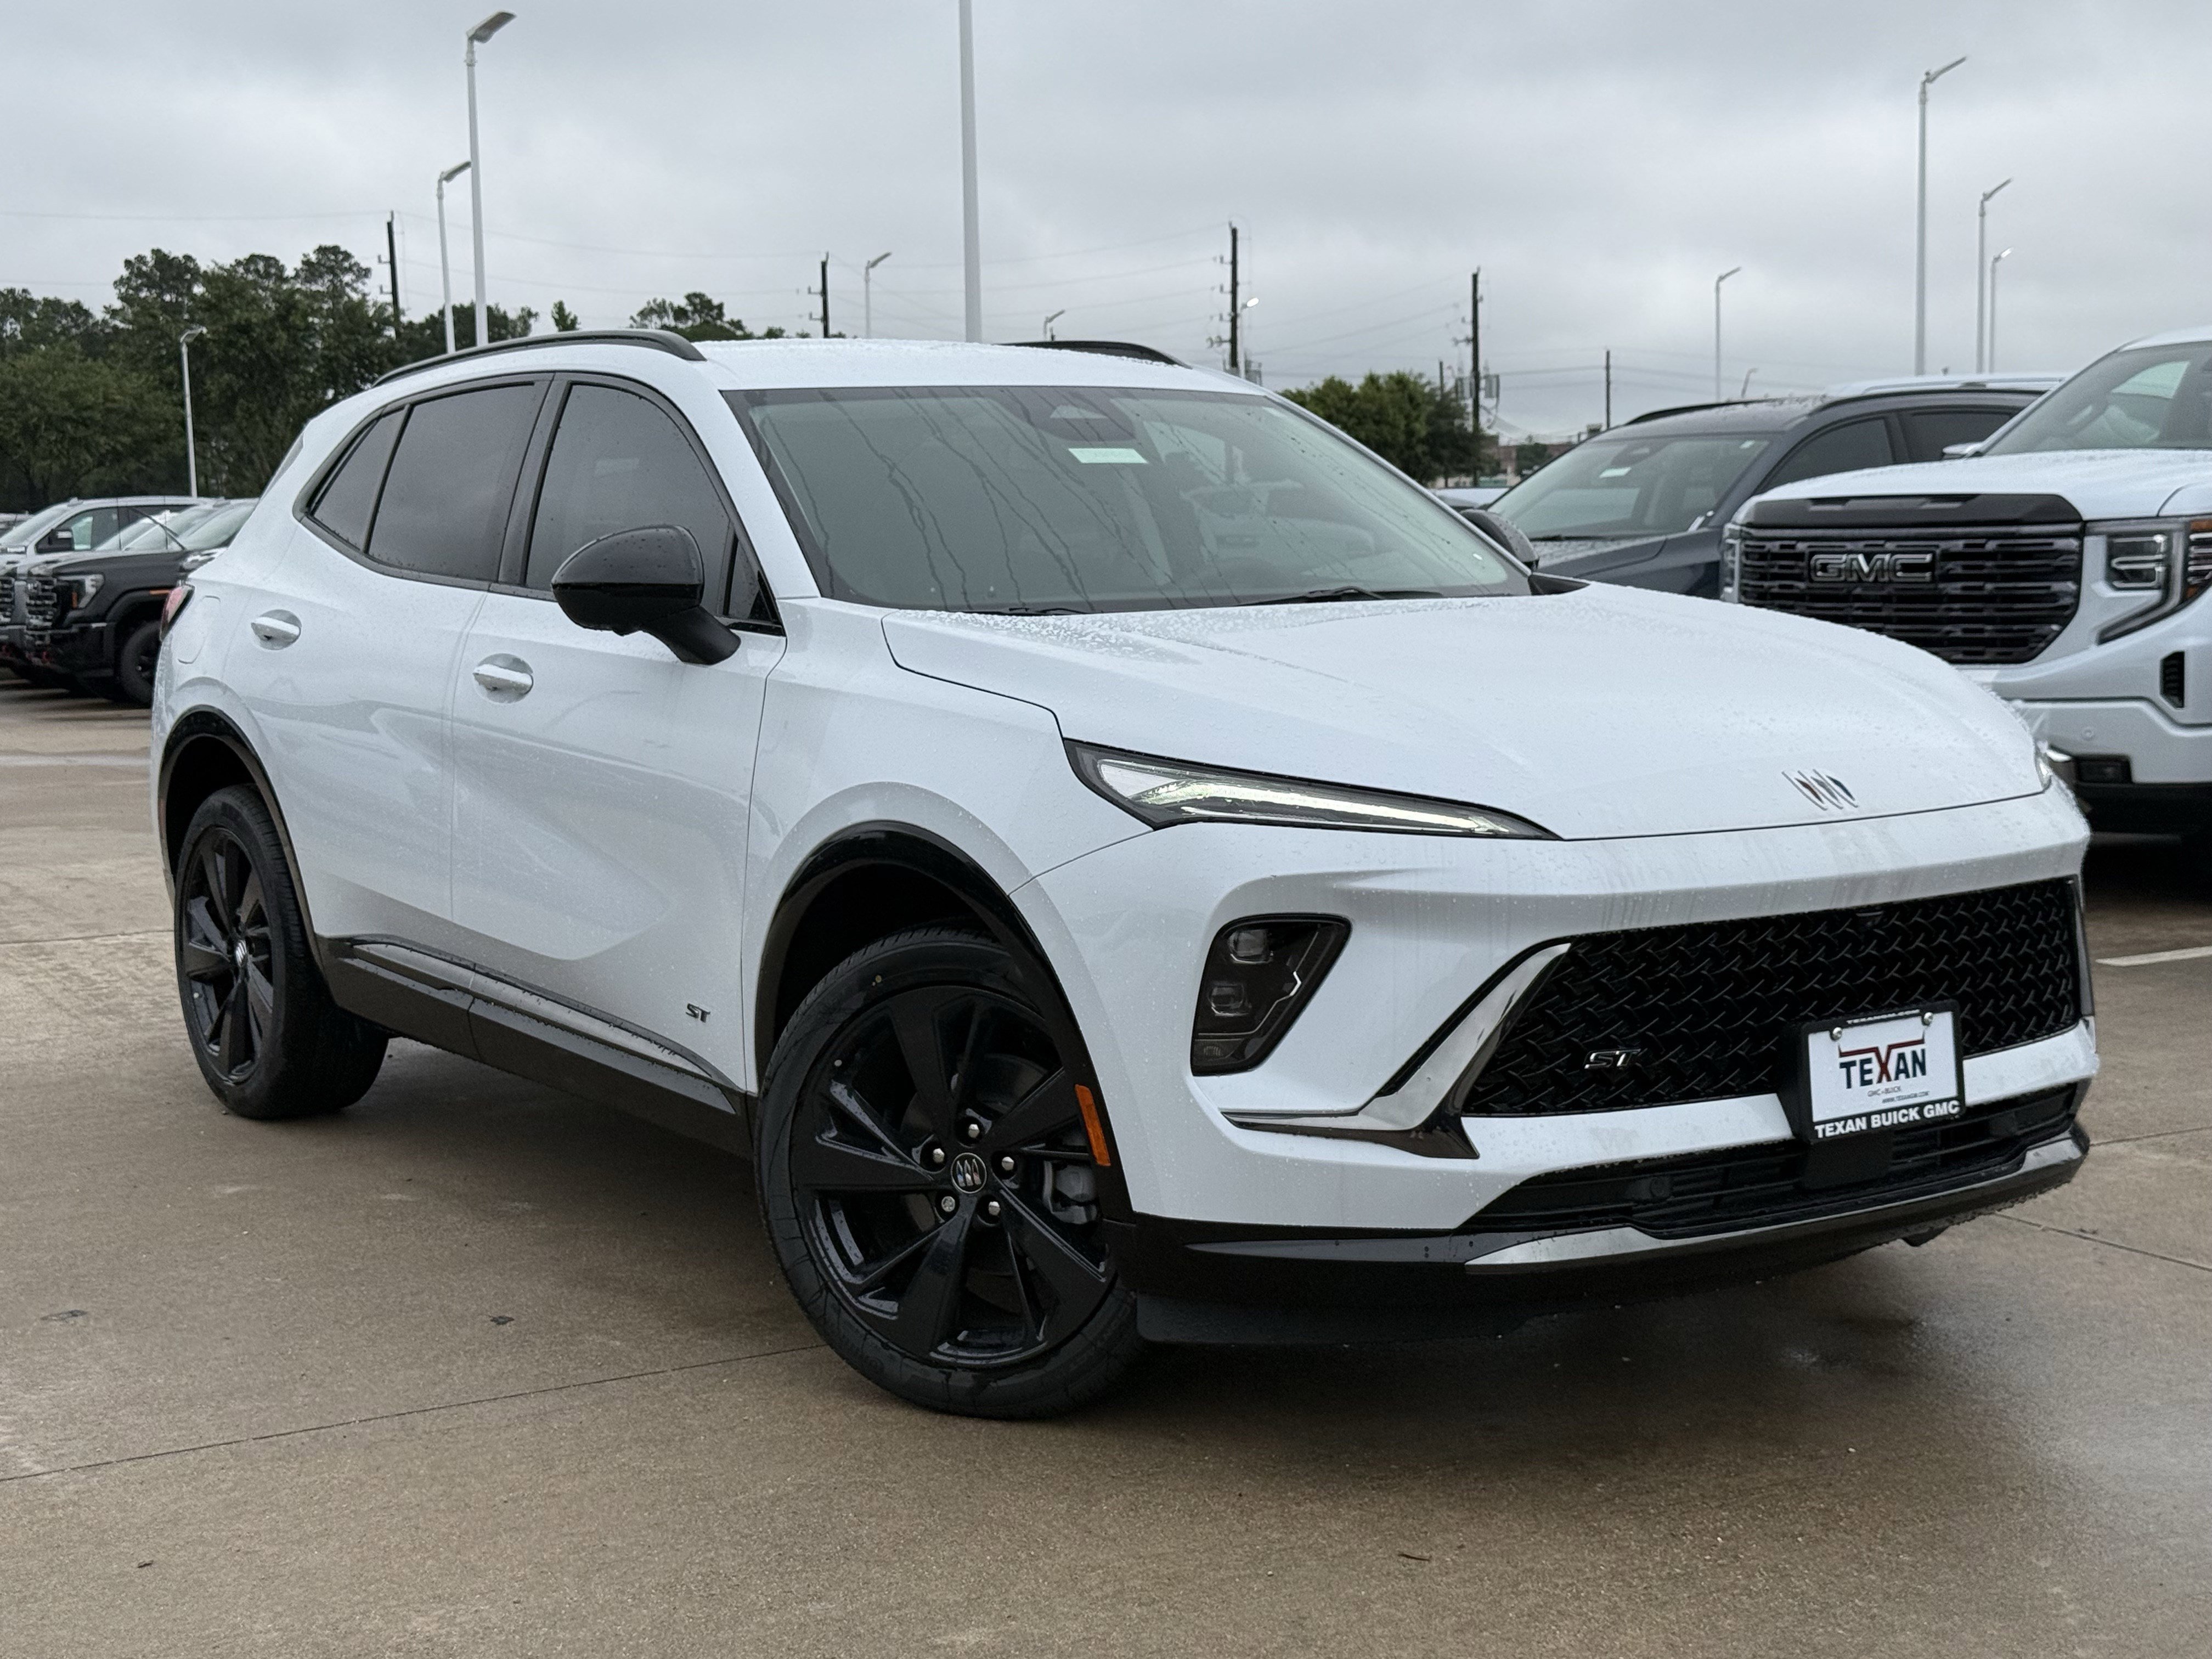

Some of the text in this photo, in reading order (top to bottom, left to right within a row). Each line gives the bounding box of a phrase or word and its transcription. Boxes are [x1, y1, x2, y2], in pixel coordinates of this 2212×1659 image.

[1810, 553, 1933, 583] GMC
[685, 1003, 711, 1024] ST
[1584, 1048, 1641, 1070] ST
[1839, 1042, 1927, 1089] TEXAN
[1814, 1099, 1960, 1138] TEXAN BUICK GMC
